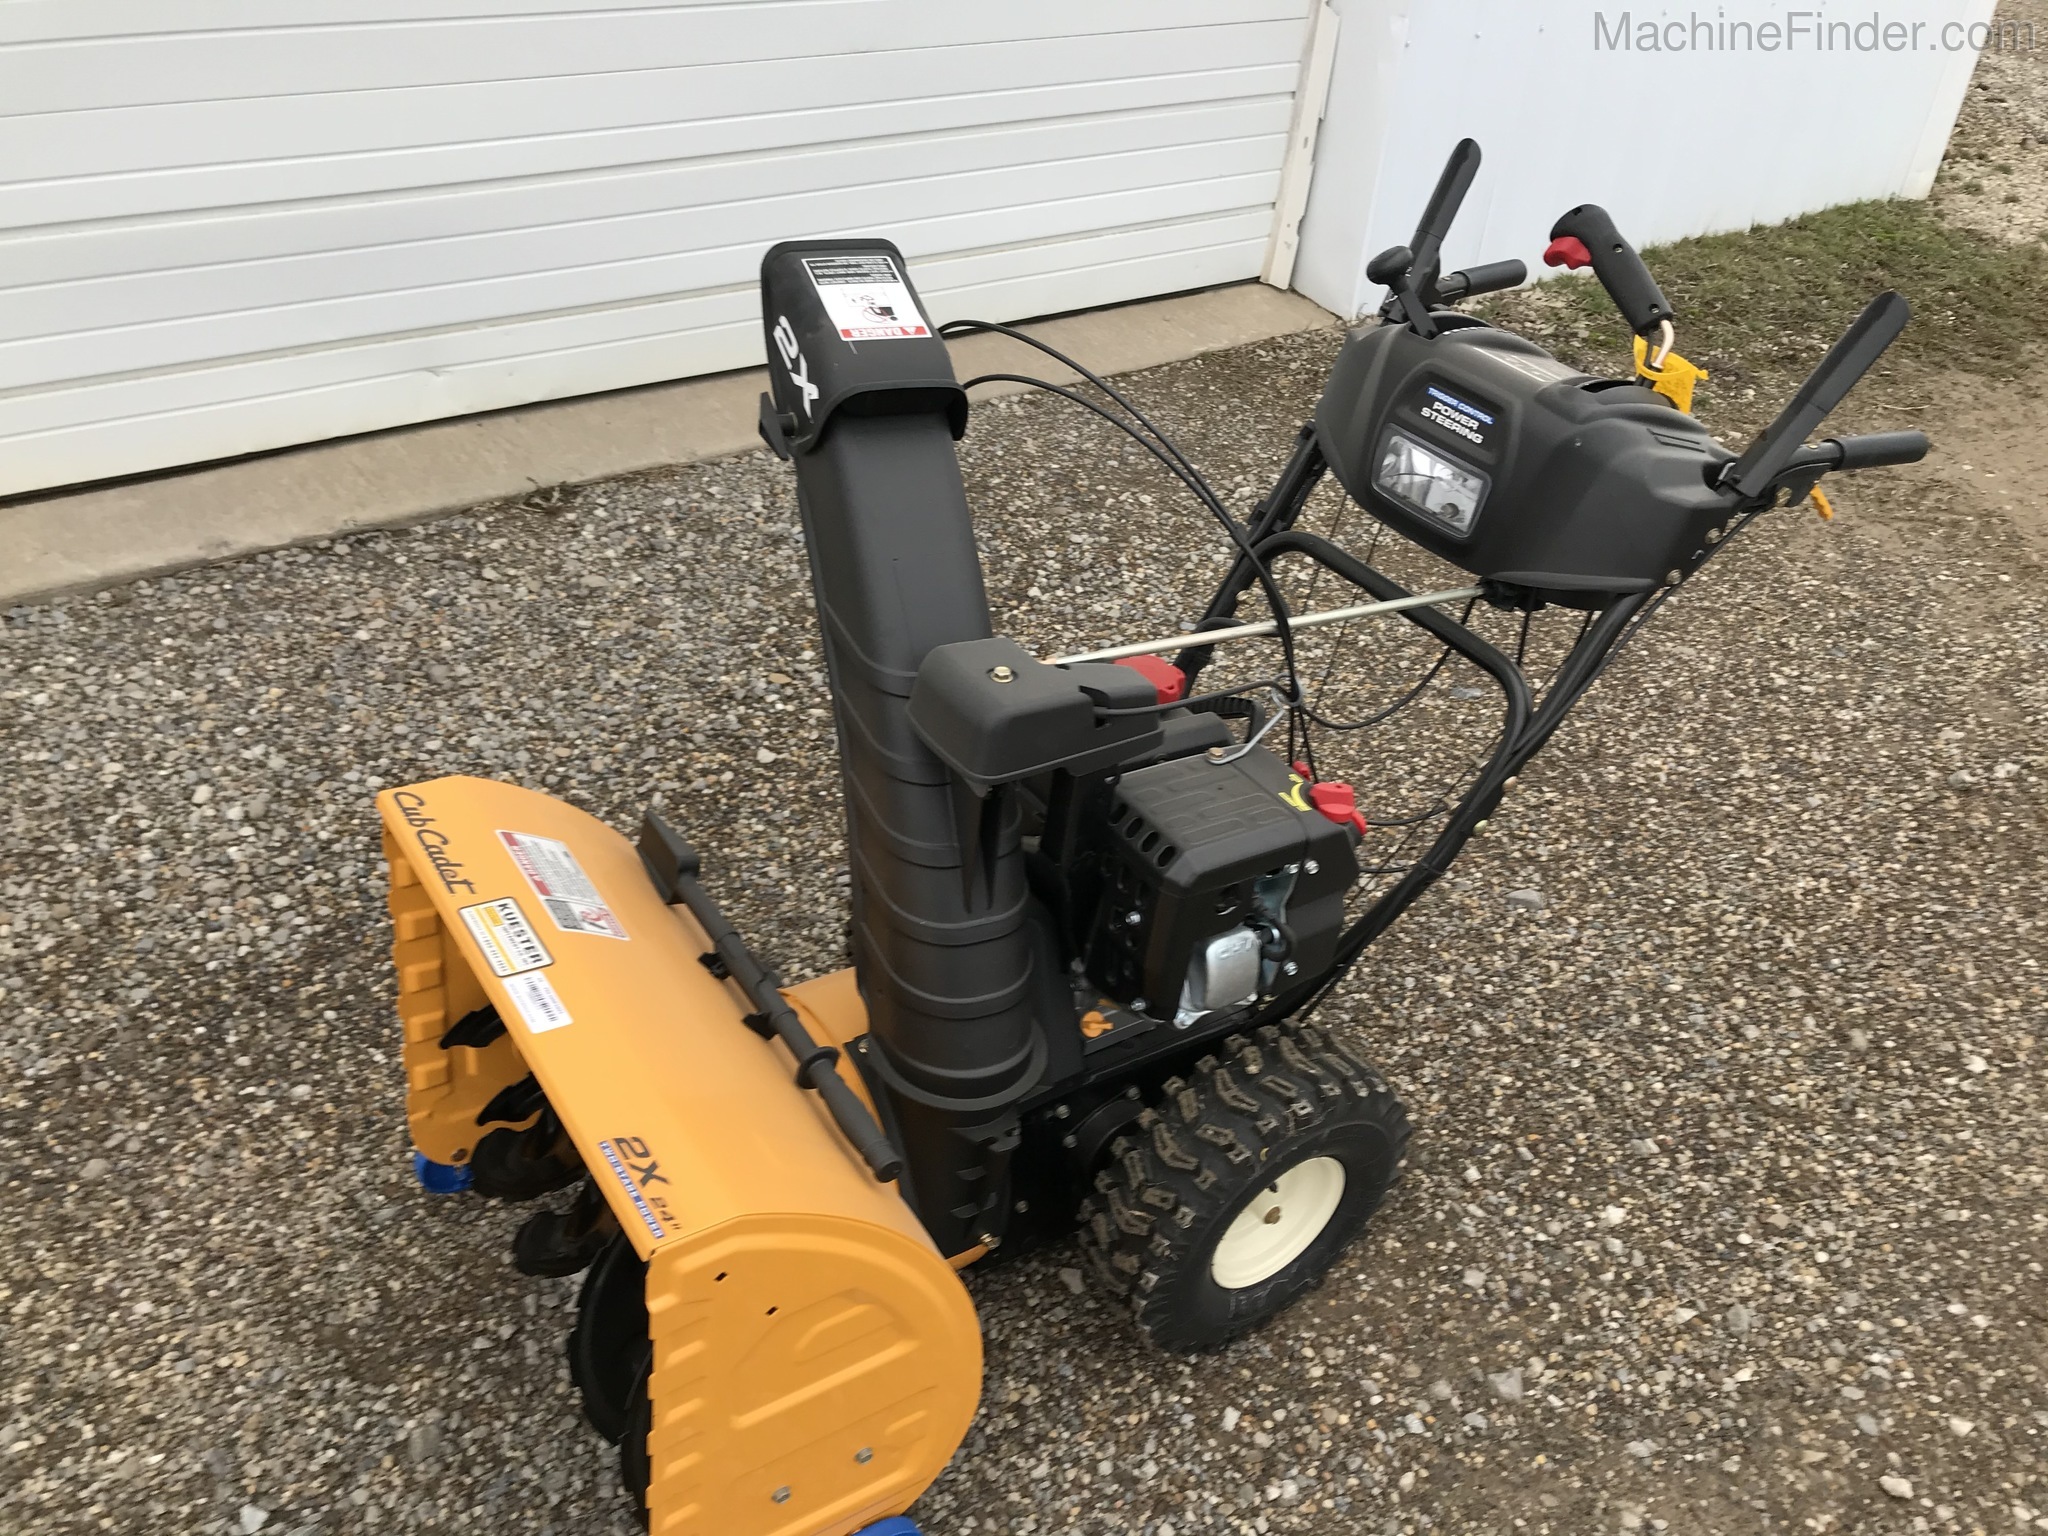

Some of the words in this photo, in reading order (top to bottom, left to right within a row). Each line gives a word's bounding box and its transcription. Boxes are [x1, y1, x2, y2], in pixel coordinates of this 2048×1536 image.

[850, 327, 904, 337] DANGER
[773, 315, 820, 423] 2X
[1420, 407, 1484, 444] STEERING
[1428, 387, 1460, 407] TRIGGER
[1458, 402, 1494, 425] CONTROL
[1432, 401, 1480, 430] POWER
[394, 791, 436, 828] Cub
[417, 829, 477, 895] Cadet
[498, 903, 543, 963] KUESTER
[613, 1136, 671, 1188] 2X
